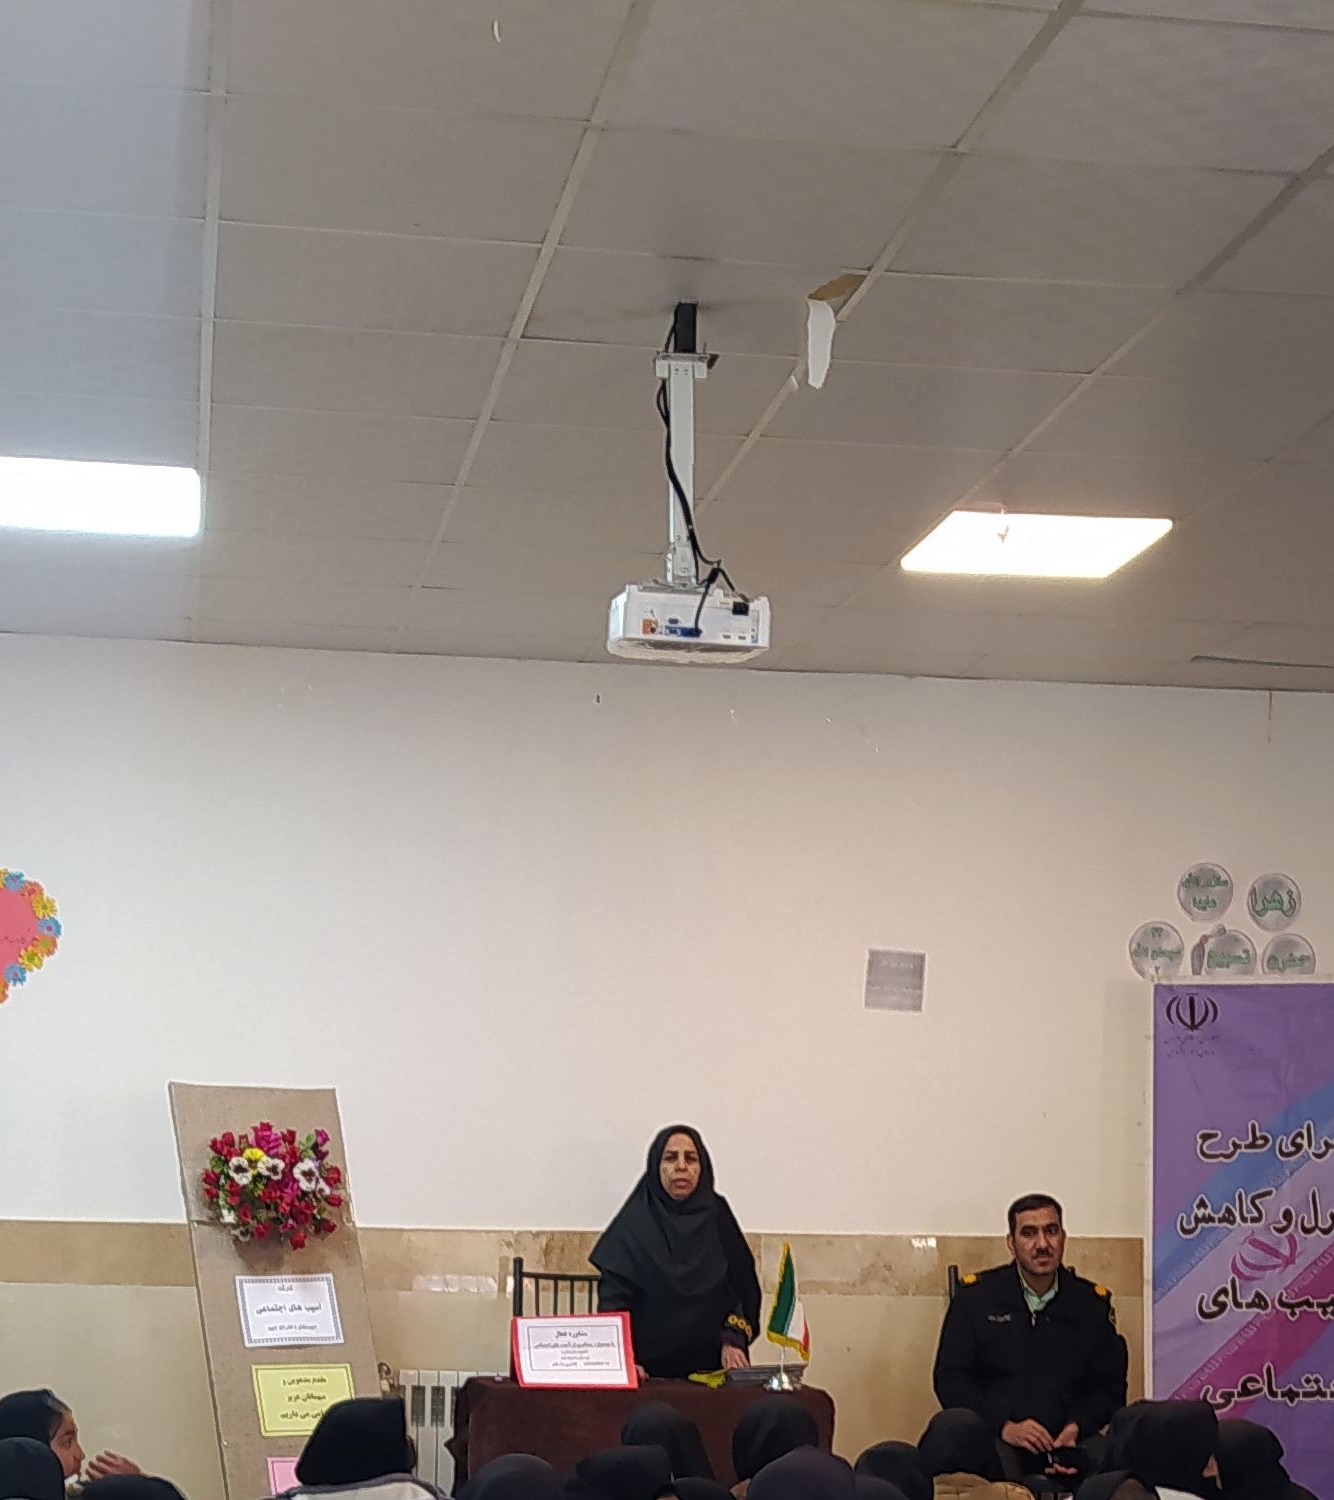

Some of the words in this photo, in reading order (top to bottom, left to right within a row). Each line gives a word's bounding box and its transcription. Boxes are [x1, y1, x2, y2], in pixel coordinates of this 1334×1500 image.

[1251, 886, 1297, 917] زهرا
[1196, 1120, 1272, 1162] طرح
[1177, 1187, 1276, 1238] کاهش
[1270, 1206, 1296, 1236] و
[255, 1303, 287, 1314] اجتماعی
[1196, 1275, 1271, 1322] های
